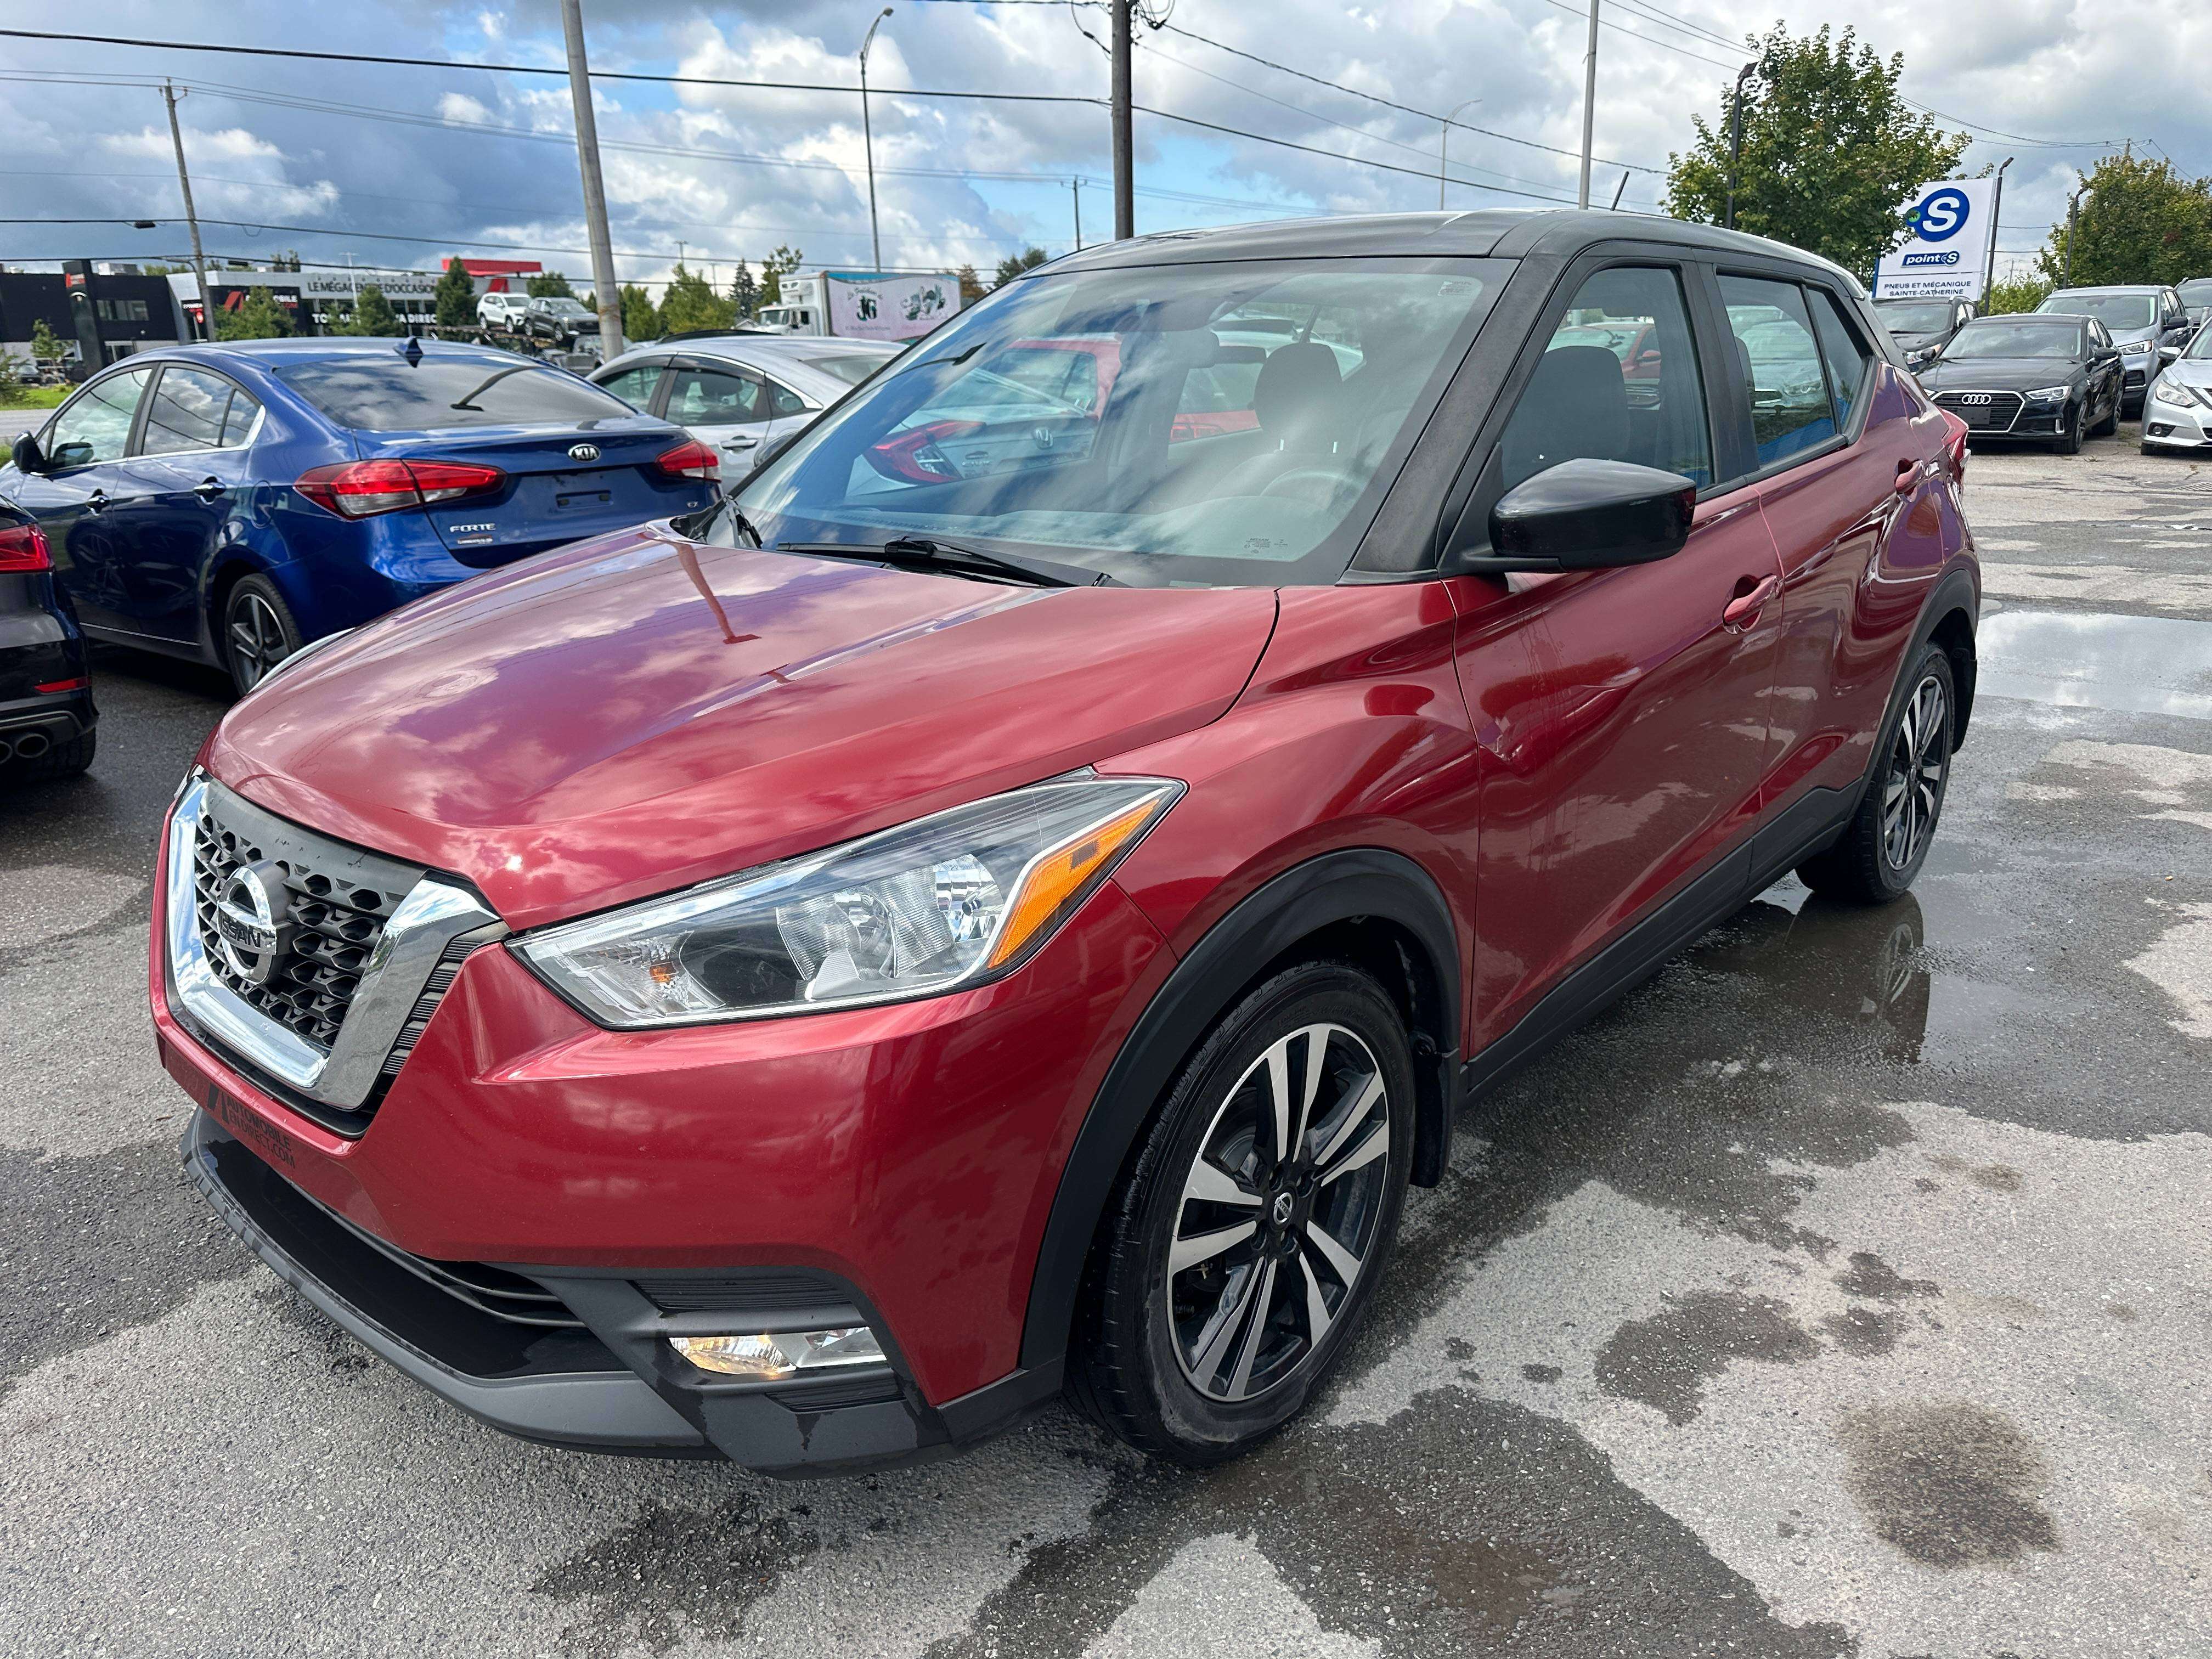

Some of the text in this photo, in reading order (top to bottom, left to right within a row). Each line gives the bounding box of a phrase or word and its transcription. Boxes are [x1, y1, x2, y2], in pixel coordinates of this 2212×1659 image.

[1922, 196, 1960, 232] S
[1906, 255, 1940, 265] point
[307, 282, 319, 292] LE
[1922, 280, 1971, 289] MÉCANIQUE
[1889, 289, 1964, 297] SAINTE-CATHERINE
[574, 447, 598, 460] KIA
[449, 523, 496, 533] FORTE
[227, 1096, 291, 1152] AUTOMOBILE
[241, 1121, 295, 1169] DIRECT.COM
